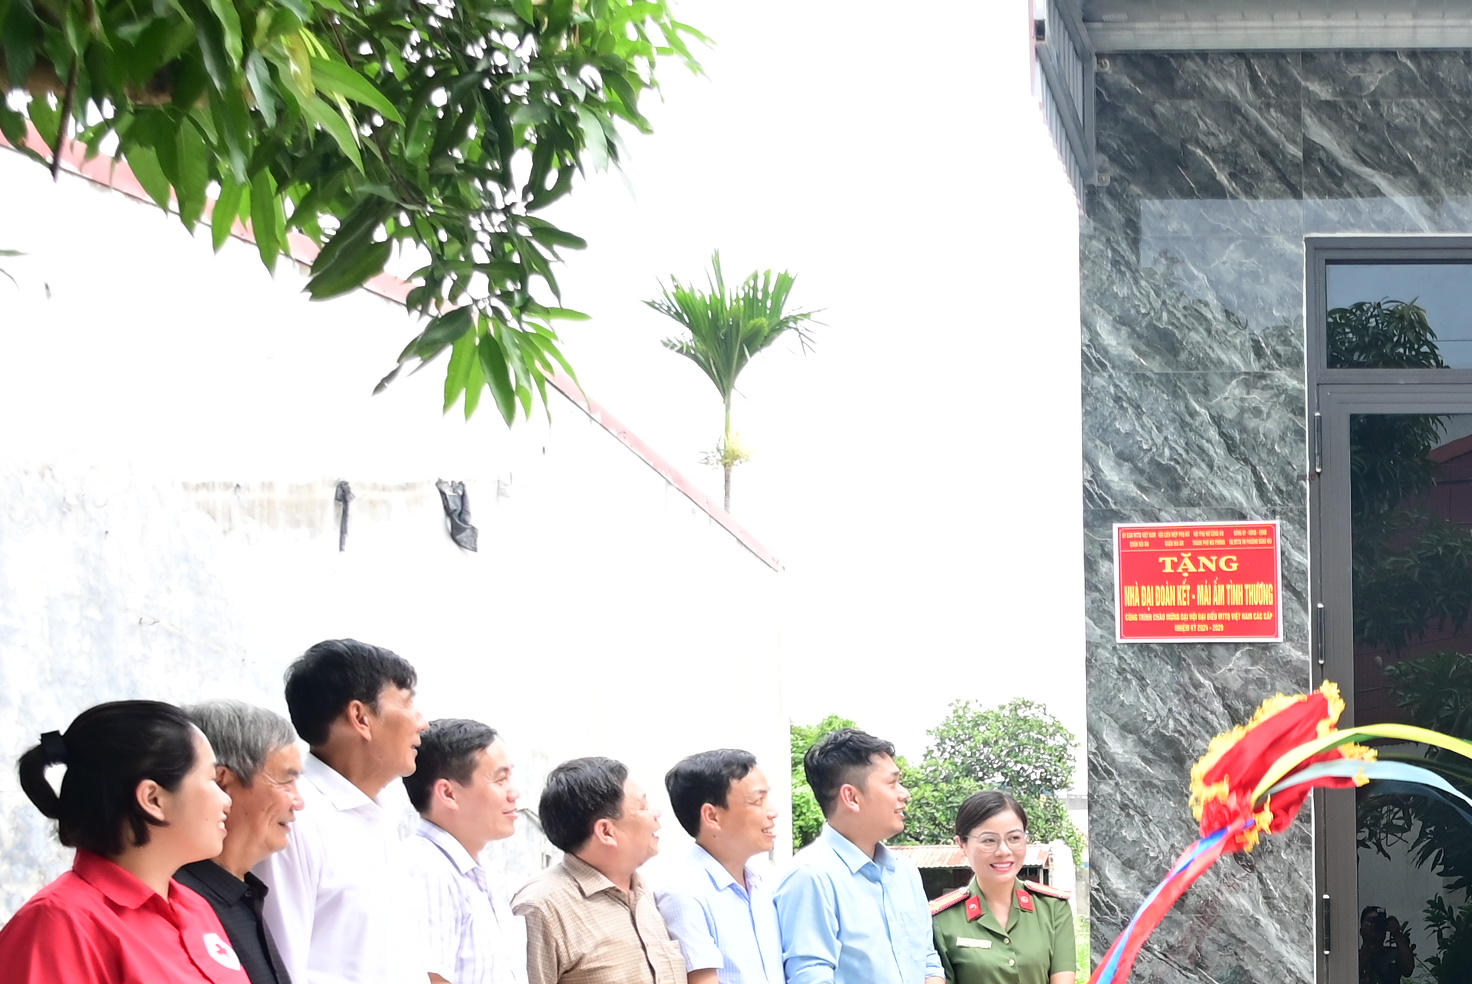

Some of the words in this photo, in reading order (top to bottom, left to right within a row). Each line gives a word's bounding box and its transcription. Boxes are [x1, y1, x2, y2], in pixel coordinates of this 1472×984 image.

[1158, 552, 1239, 577] TẶNG
[1124, 581, 1140, 607] NHÀ
[1141, 585, 1154, 611] ĐẠI
[1155, 580, 1176, 607] ĐOÀN
[1177, 578, 1191, 606] KẾT
[1197, 580, 1212, 606] MÁI
[1212, 577, 1225, 606] ẤM
[1226, 579, 1244, 606] TÌNH
[1244, 581, 1274, 606] THƯƠNG
